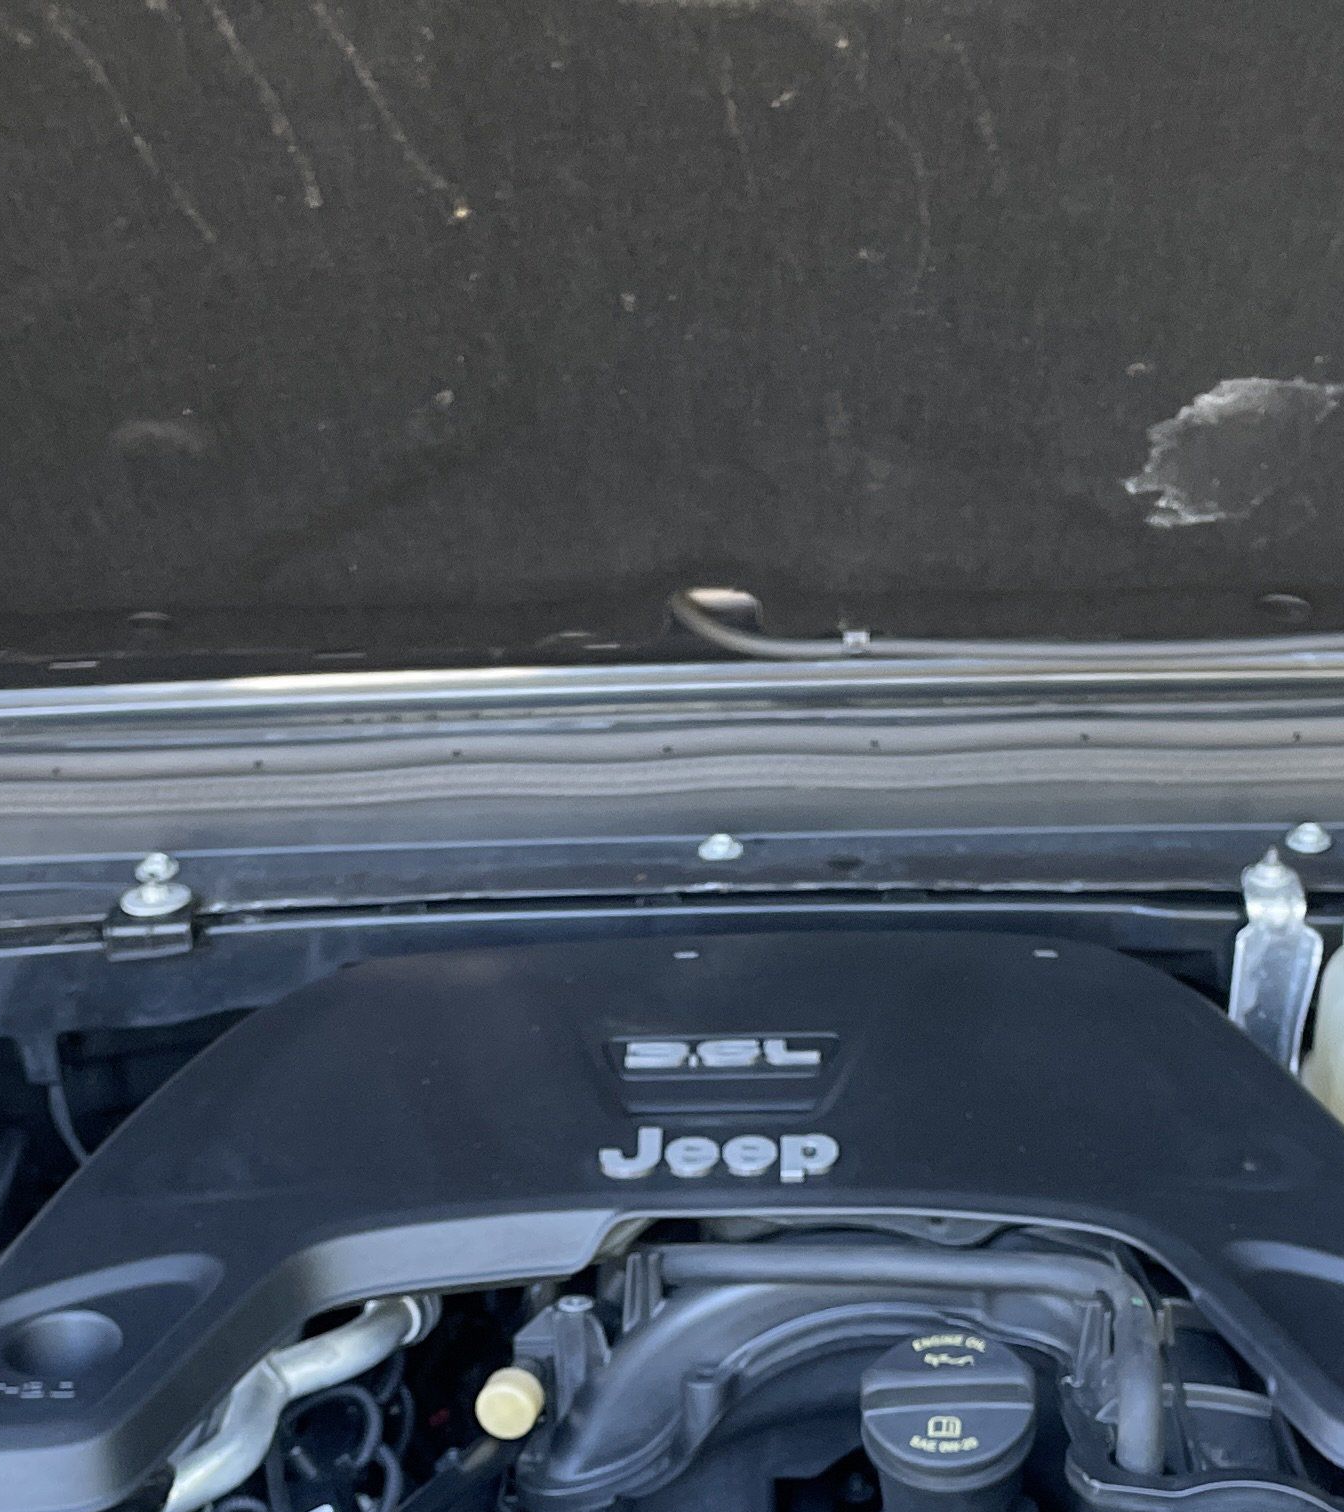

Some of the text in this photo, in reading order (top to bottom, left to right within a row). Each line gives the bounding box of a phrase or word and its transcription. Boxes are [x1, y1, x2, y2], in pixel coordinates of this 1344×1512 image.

[598, 1125, 840, 1184] Jeep
[912, 1333, 987, 1353] ENGINE OIL
